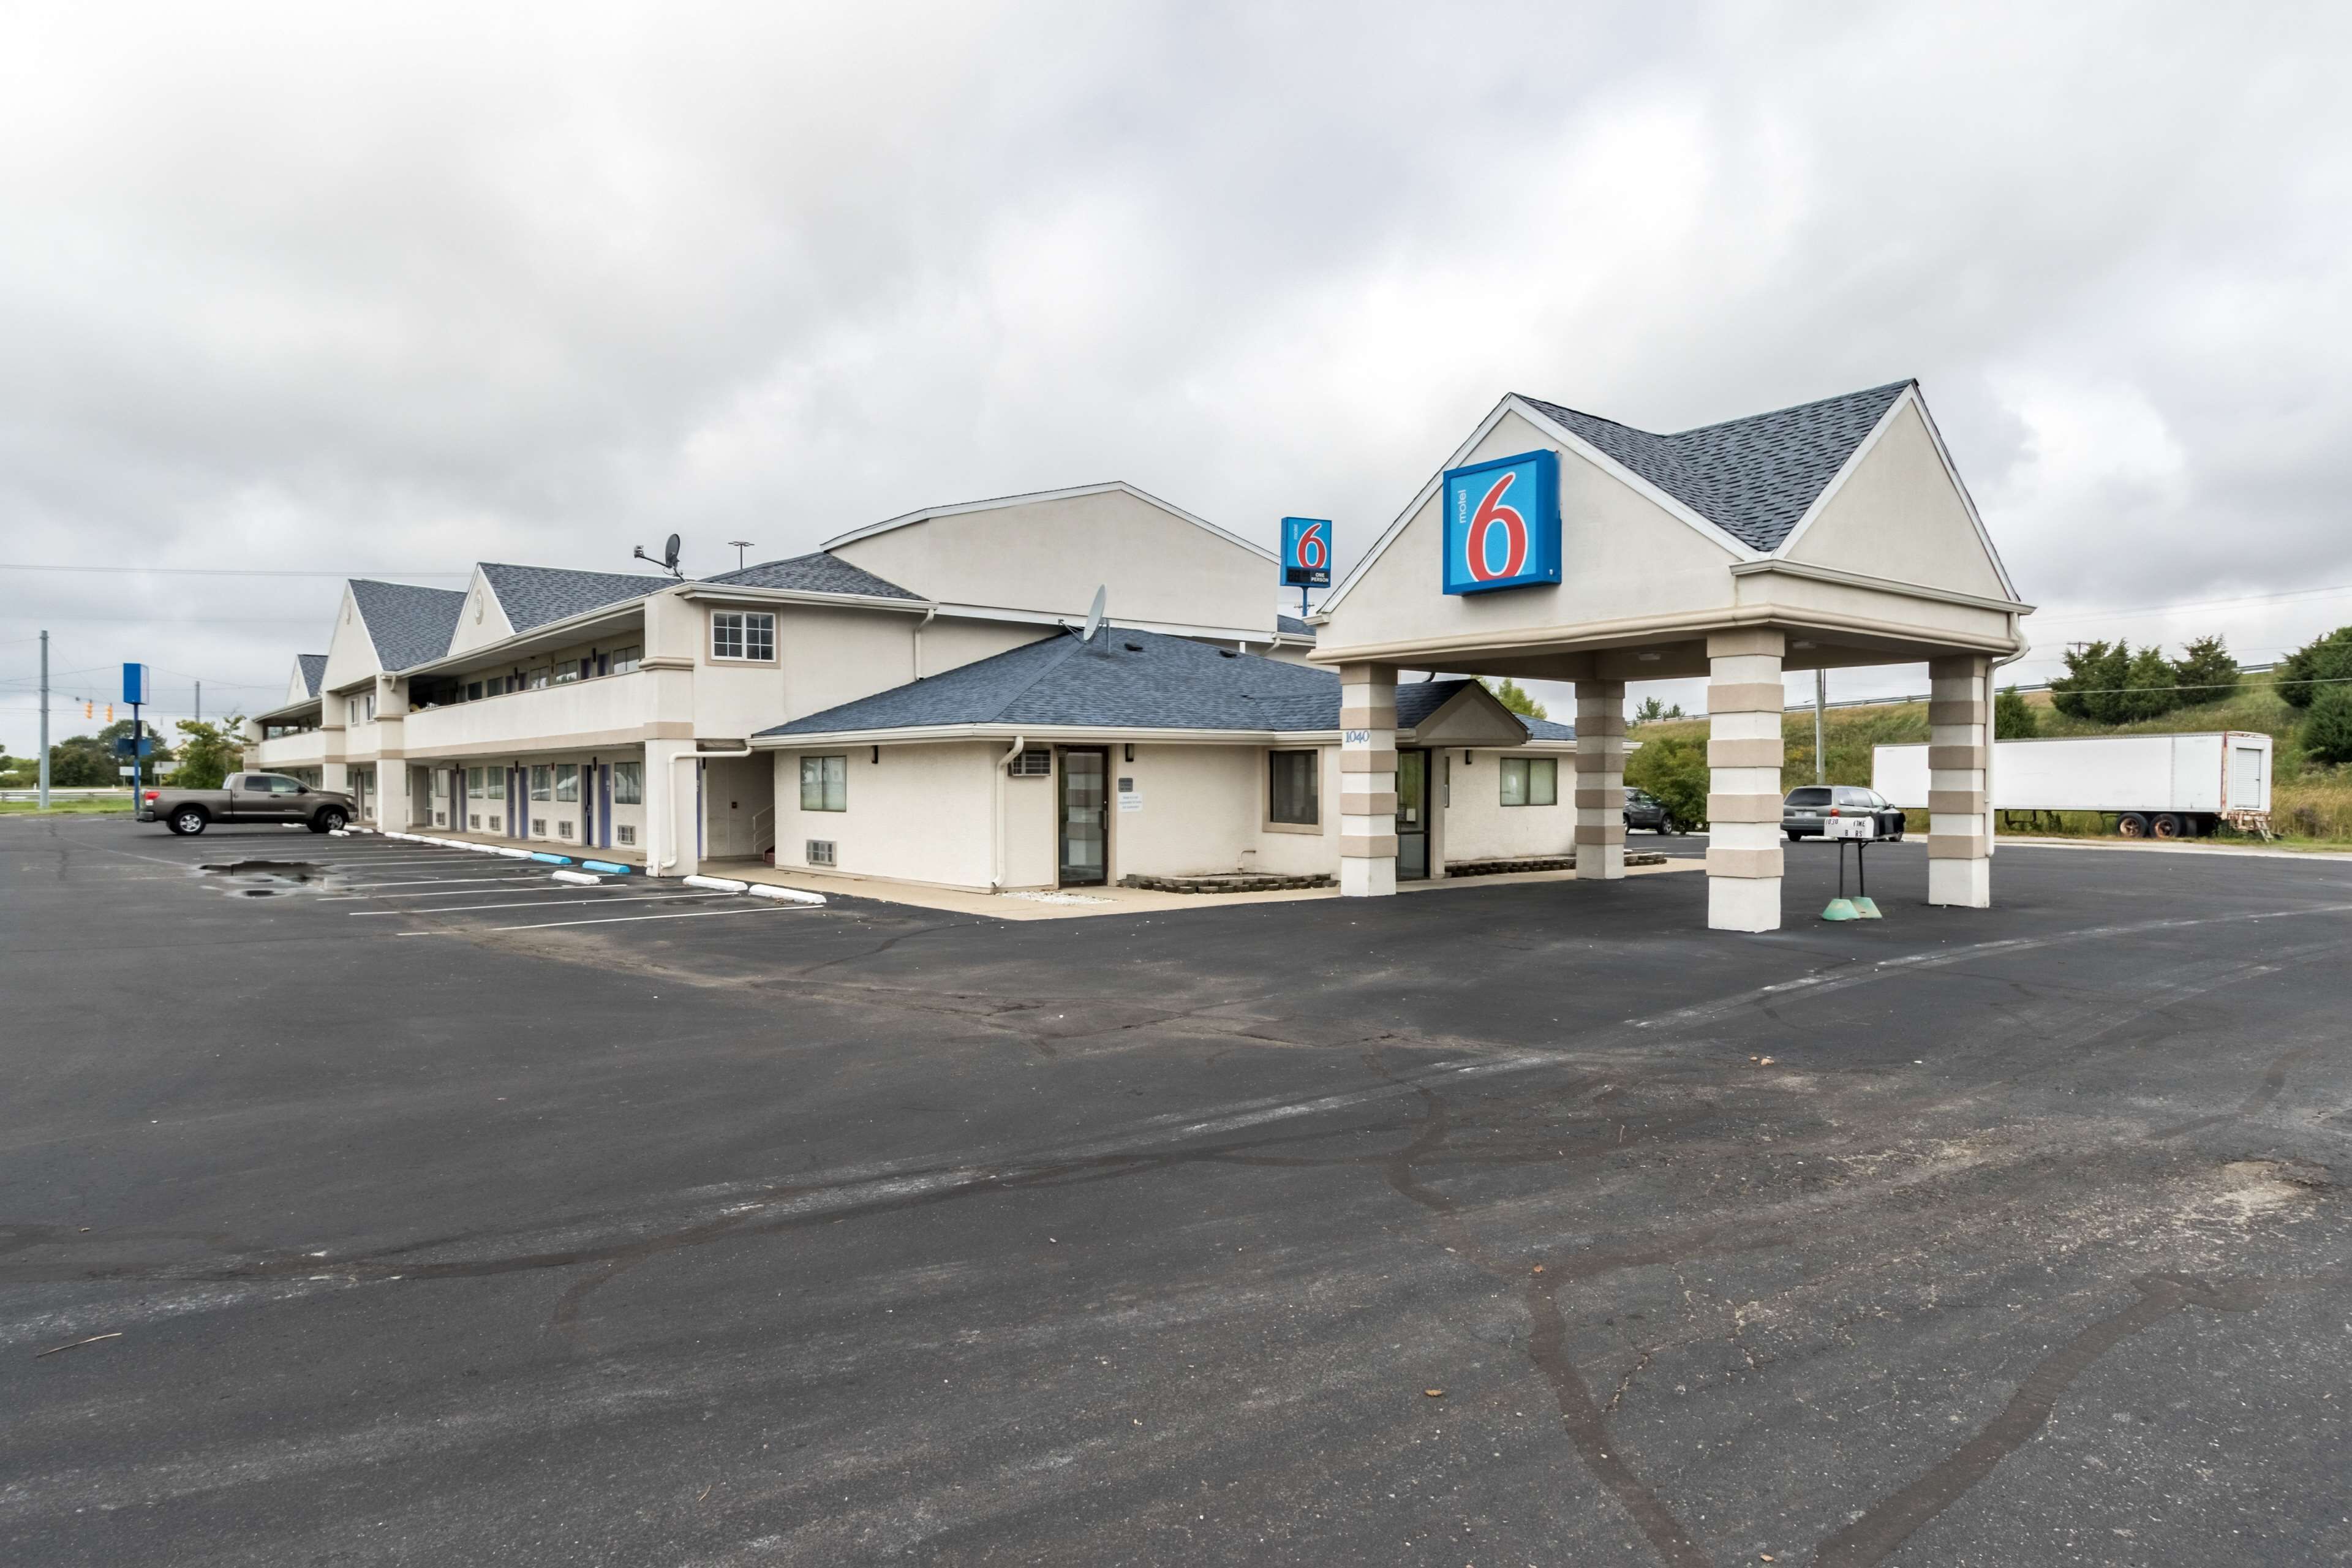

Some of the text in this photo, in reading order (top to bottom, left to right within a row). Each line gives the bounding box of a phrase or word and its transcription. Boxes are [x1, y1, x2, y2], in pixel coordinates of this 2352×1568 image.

[1457, 489, 1466, 524] motel
[1466, 471, 1528, 582] 6
[1297, 523, 1327, 568] 6
[1345, 730, 1370, 744] 1040
